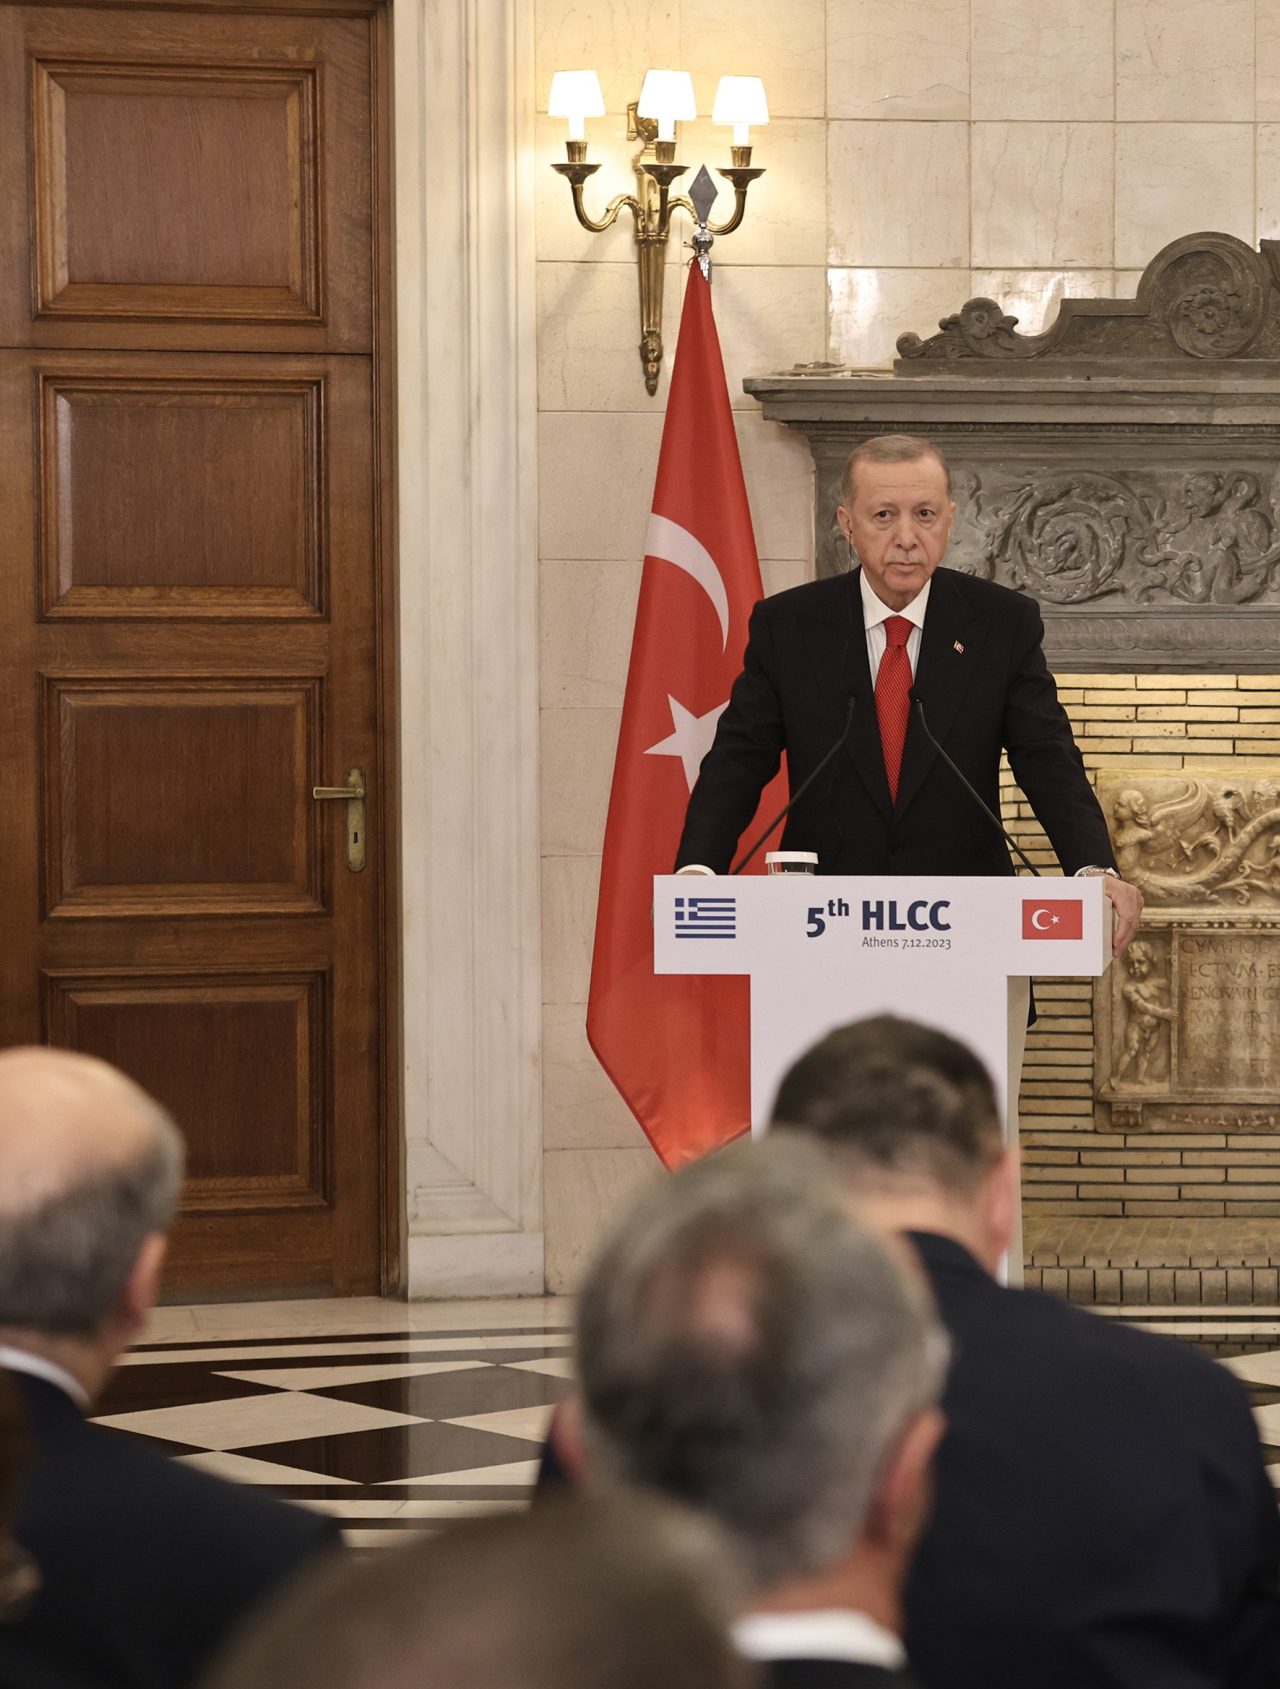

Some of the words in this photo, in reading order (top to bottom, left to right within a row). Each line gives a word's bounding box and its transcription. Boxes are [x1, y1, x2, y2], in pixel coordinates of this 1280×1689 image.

[806, 898, 850, 938] 5th
[862, 900, 952, 931] HLCC
[862, 936, 899, 948] Athens
[901, 938, 952, 951] 7.12.2023
